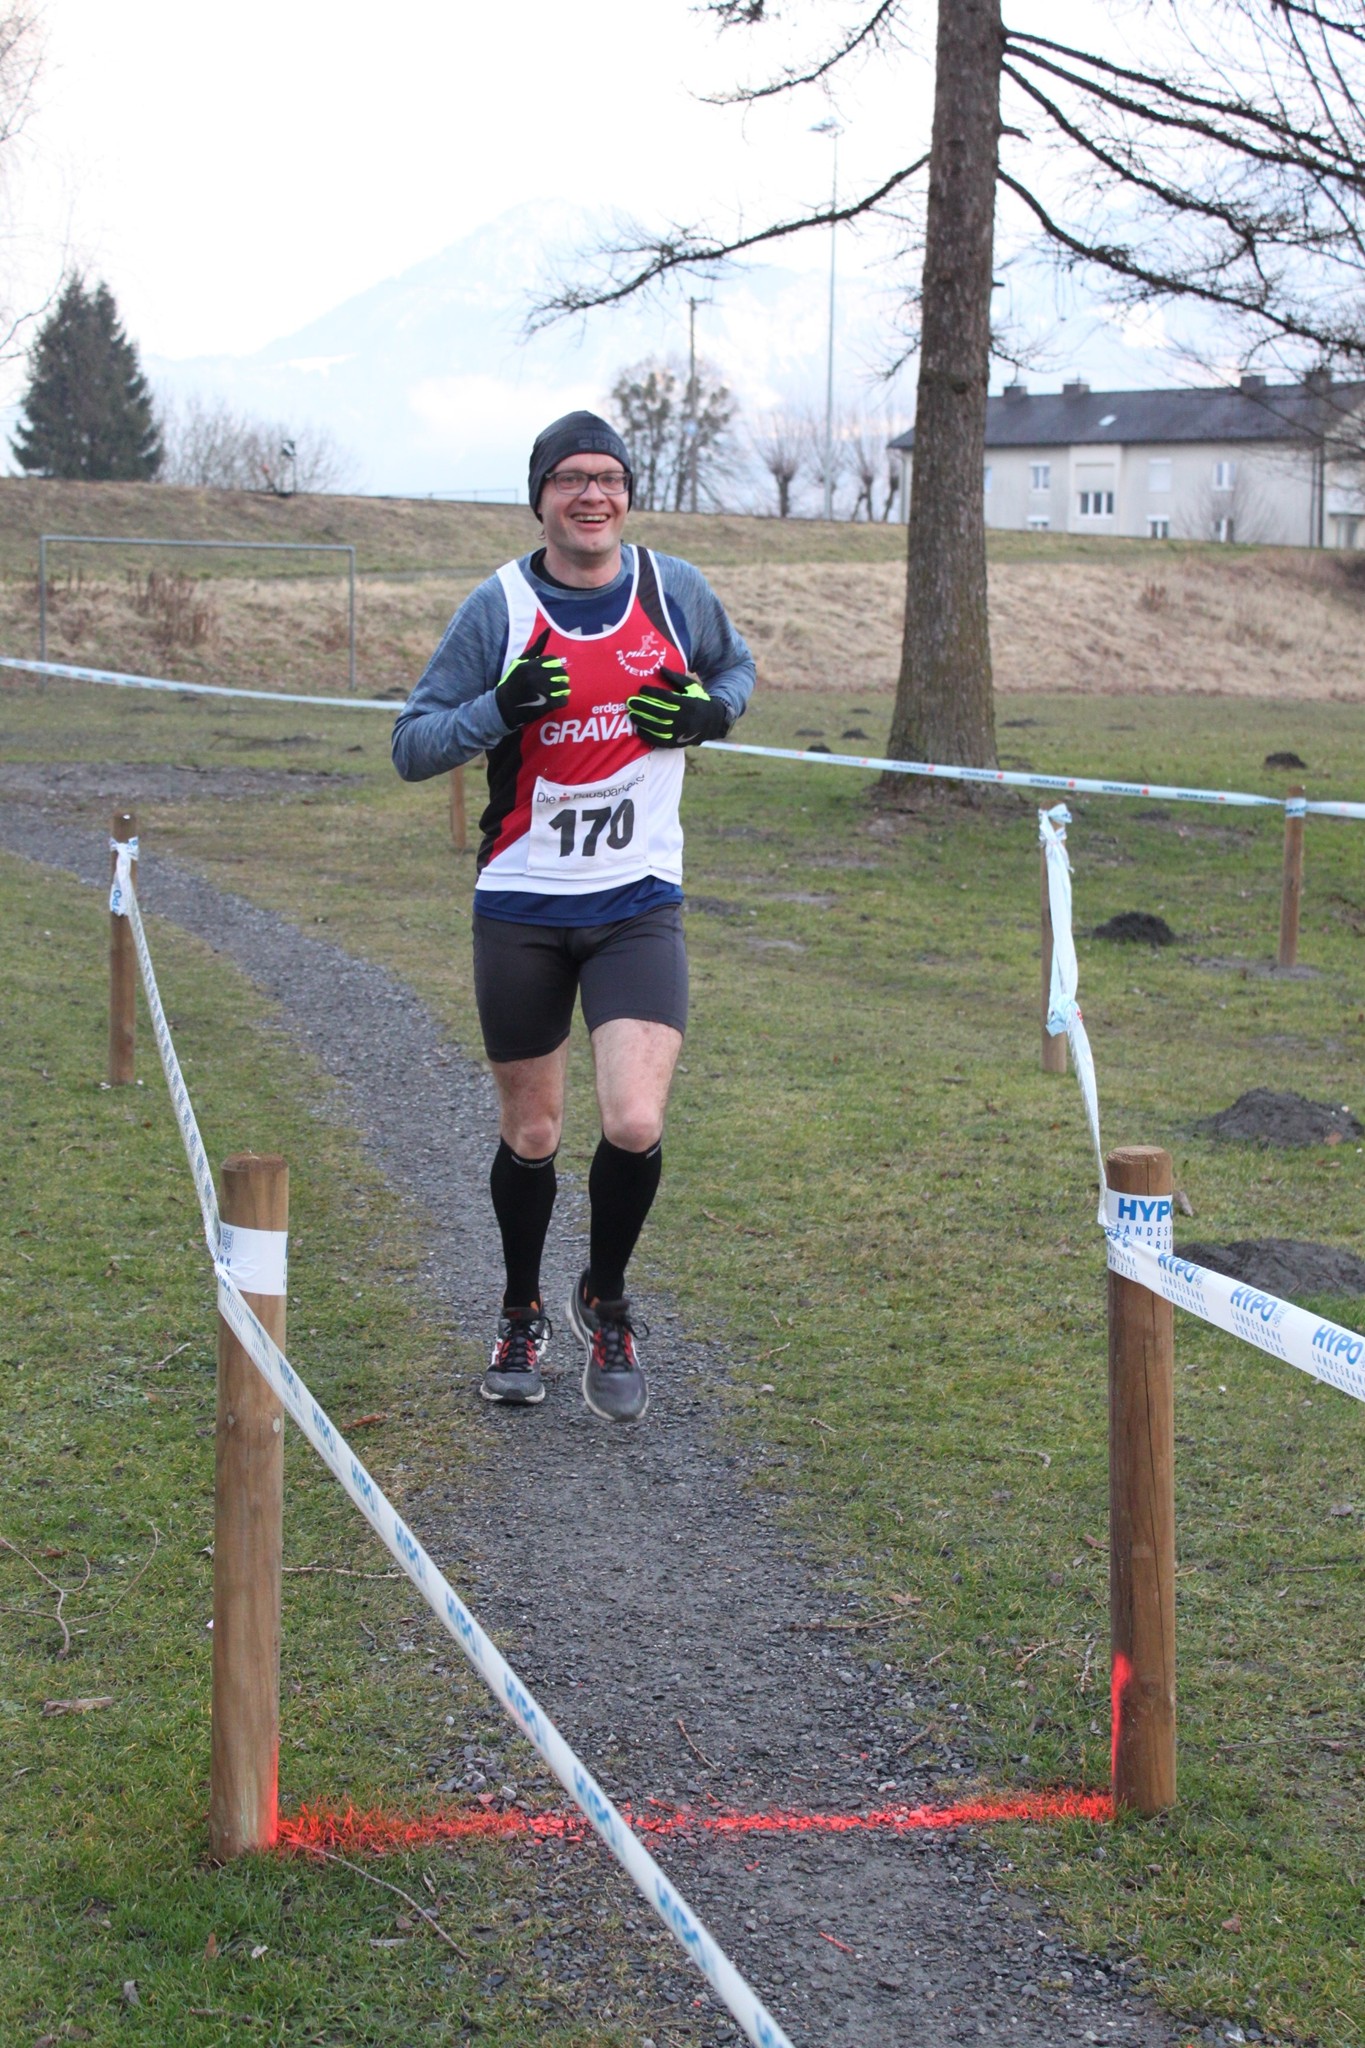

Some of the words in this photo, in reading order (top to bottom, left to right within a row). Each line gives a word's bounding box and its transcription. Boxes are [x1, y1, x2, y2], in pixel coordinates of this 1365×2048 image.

[616, 647, 667, 677] RHEINTAL
[592, 702, 629, 714] erdga
[540, 713, 638, 746] GRAVA
[536, 791, 557, 805] Die
[548, 798, 635, 858] 170
[1117, 1197, 1174, 1223] HYP
[1157, 1252, 1200, 1284] HYPO
[1230, 1286, 1278, 1322] HYPO
[1312, 1324, 1363, 1365] HYPO
[1311, 1350, 1365, 1385] LANDESBAN
